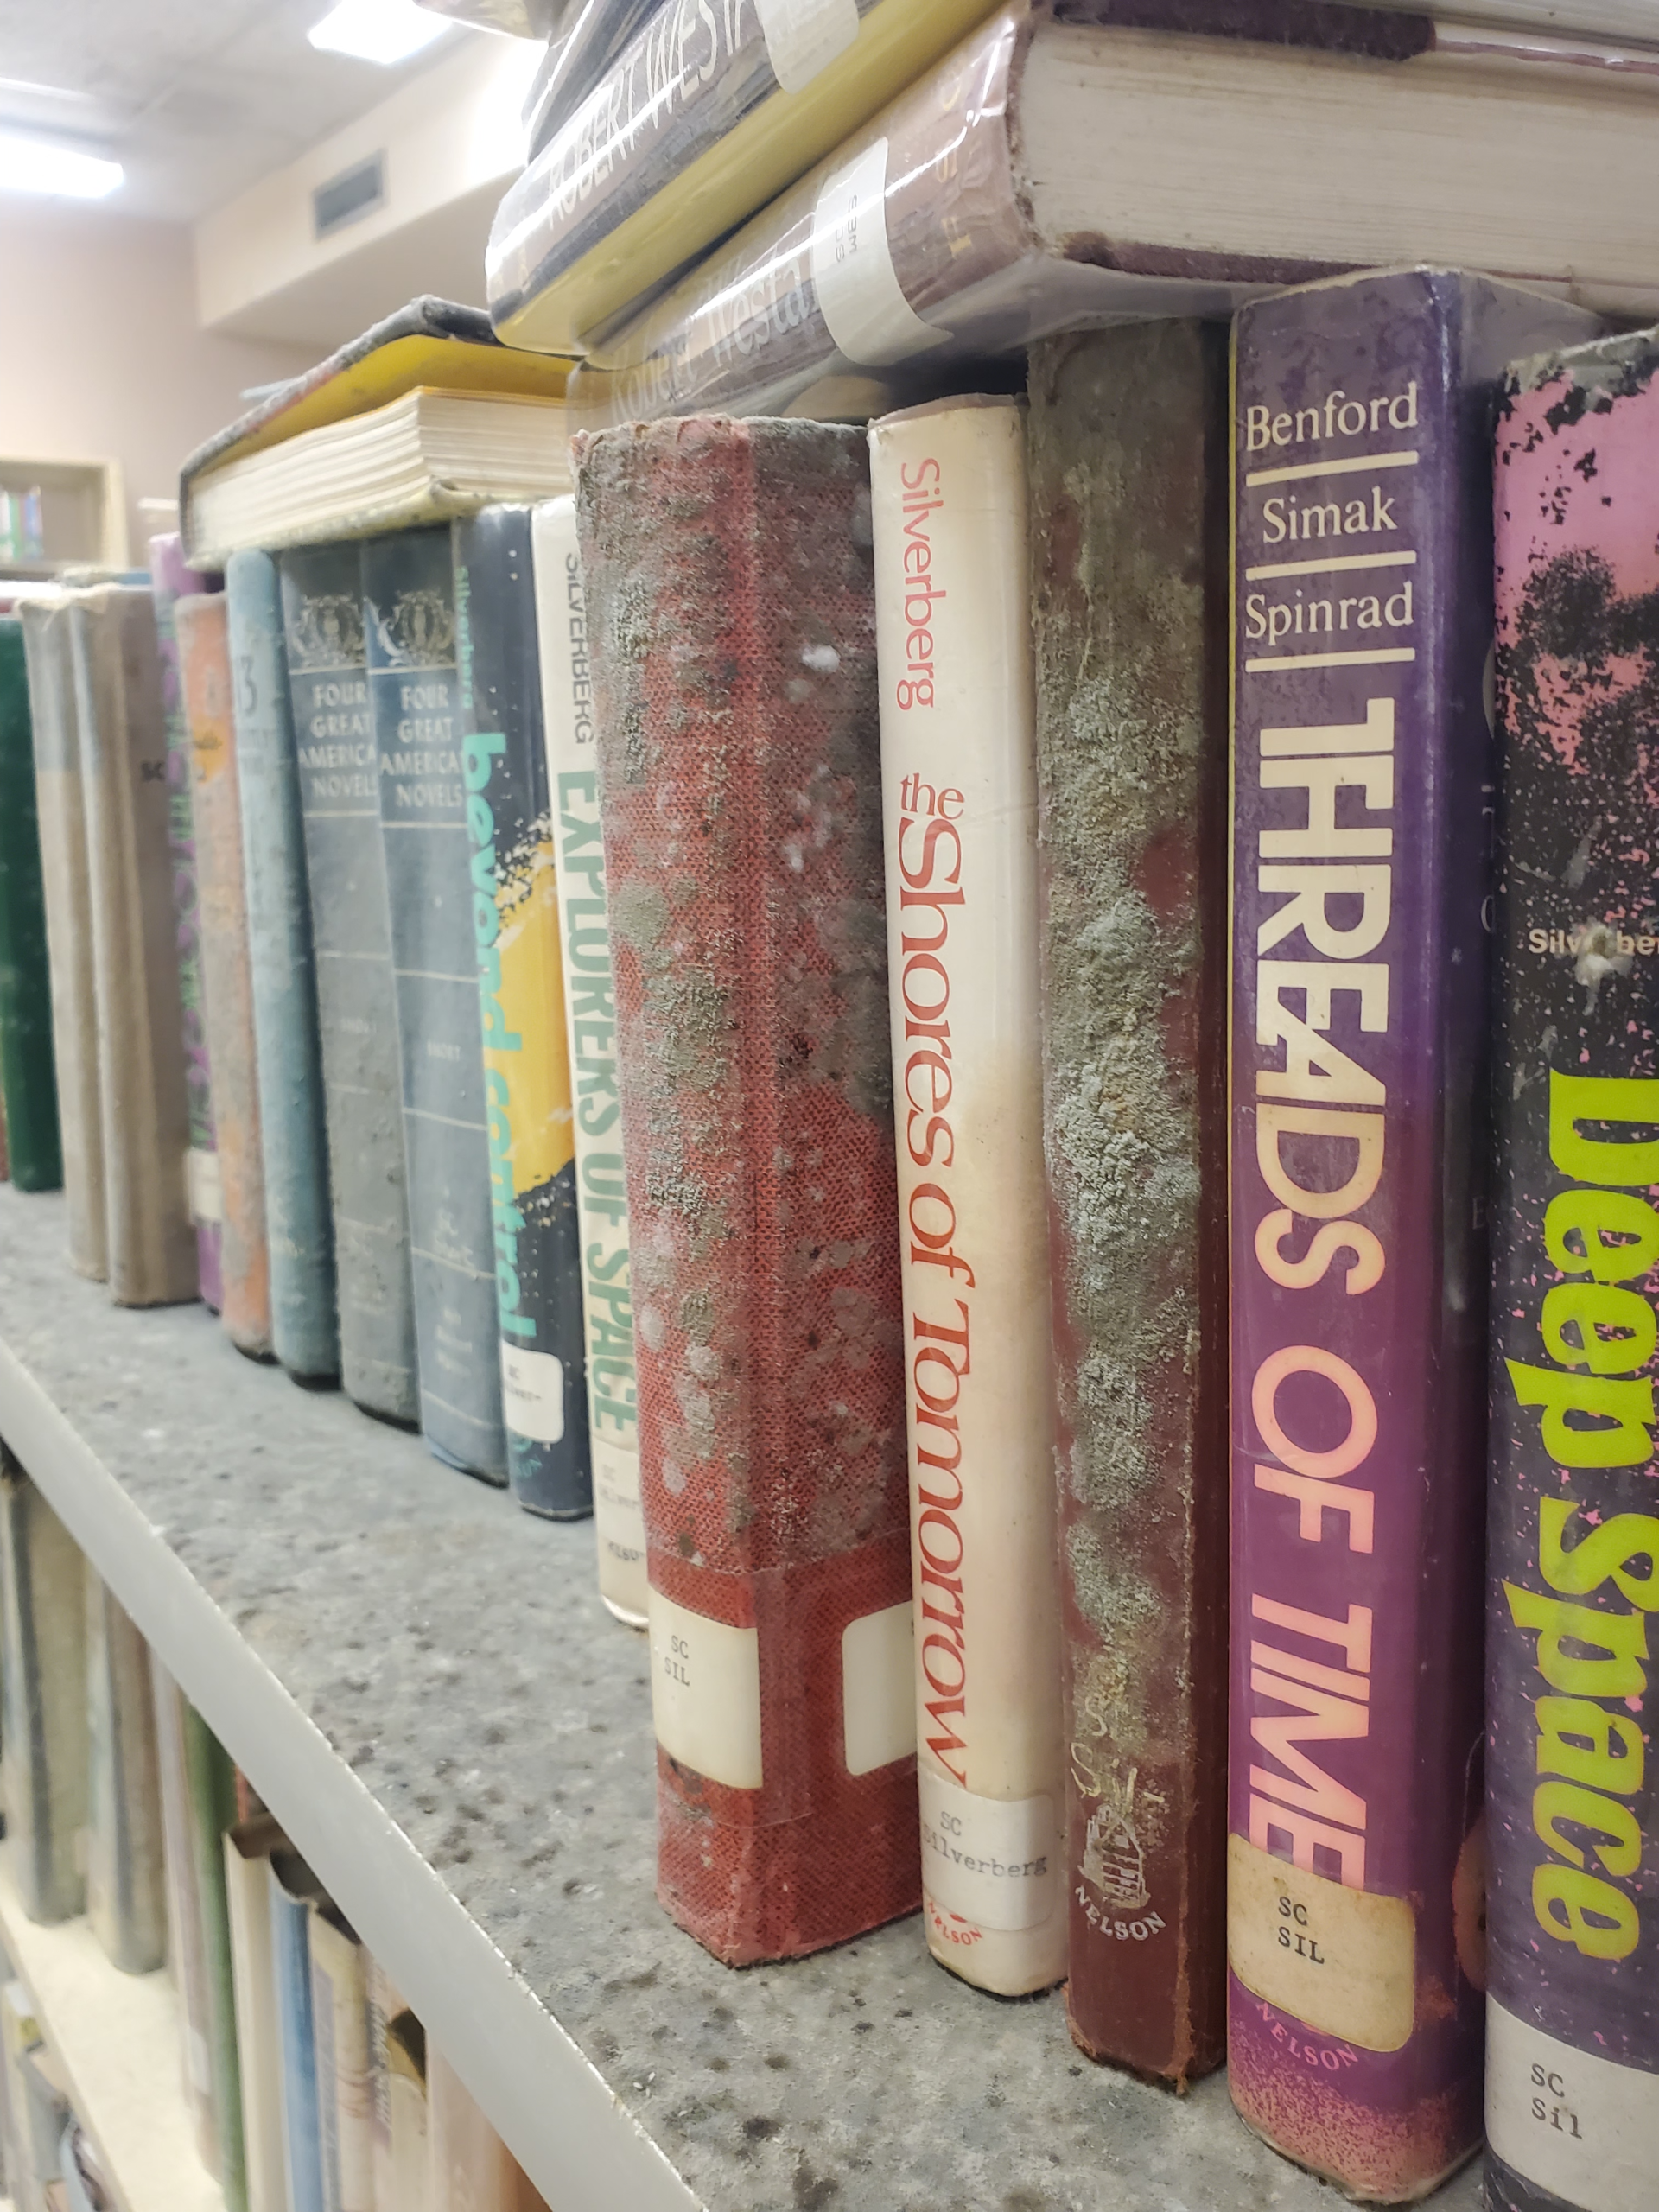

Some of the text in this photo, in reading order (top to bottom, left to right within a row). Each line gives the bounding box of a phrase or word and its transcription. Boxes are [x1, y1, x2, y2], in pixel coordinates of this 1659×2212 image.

[835, 226, 845, 263] SC
[1246, 380, 1419, 452] Benford
[1262, 486, 1398, 544] Simak
[895, 456, 947, 712] Silverberg
[1244, 581, 1414, 646] Spinrad
[312, 681, 367, 709] FOUR
[400, 683, 448, 711] FOUR
[309, 713, 372, 739] GREAT
[397, 716, 454, 744] GREAT
[298, 743, 377, 769] AMERICA
[380, 749, 465, 777] AMERICA
[311, 774, 378, 798] NOVEL
[395, 783, 463, 808] NOVELS
[899, 771, 966, 821] the
[462, 733, 524, 1052] beyond
[898, 817, 976, 1789] Shores of Tomorrow
[1249, 697, 1395, 1892] THREADS OF TIME
[586, 1241, 638, 1432] SPACE
[1501, 1067, 1659, 1961] Deep Space
[671, 1634, 690, 1660] SC
[664, 1658, 690, 1688] SIL
[939, 1810, 963, 1837] SC
[922, 1822, 1048, 1878] Silverberg
[1074, 1884, 1166, 1942] NELSON
[1277, 1895, 1309, 1927] SC
[1276, 1926, 1325, 1965] SIL
[1255, 2001, 1360, 2072] NELSON
[1530, 2063, 1566, 2099] SC
[1530, 2097, 1584, 2140] Sil
